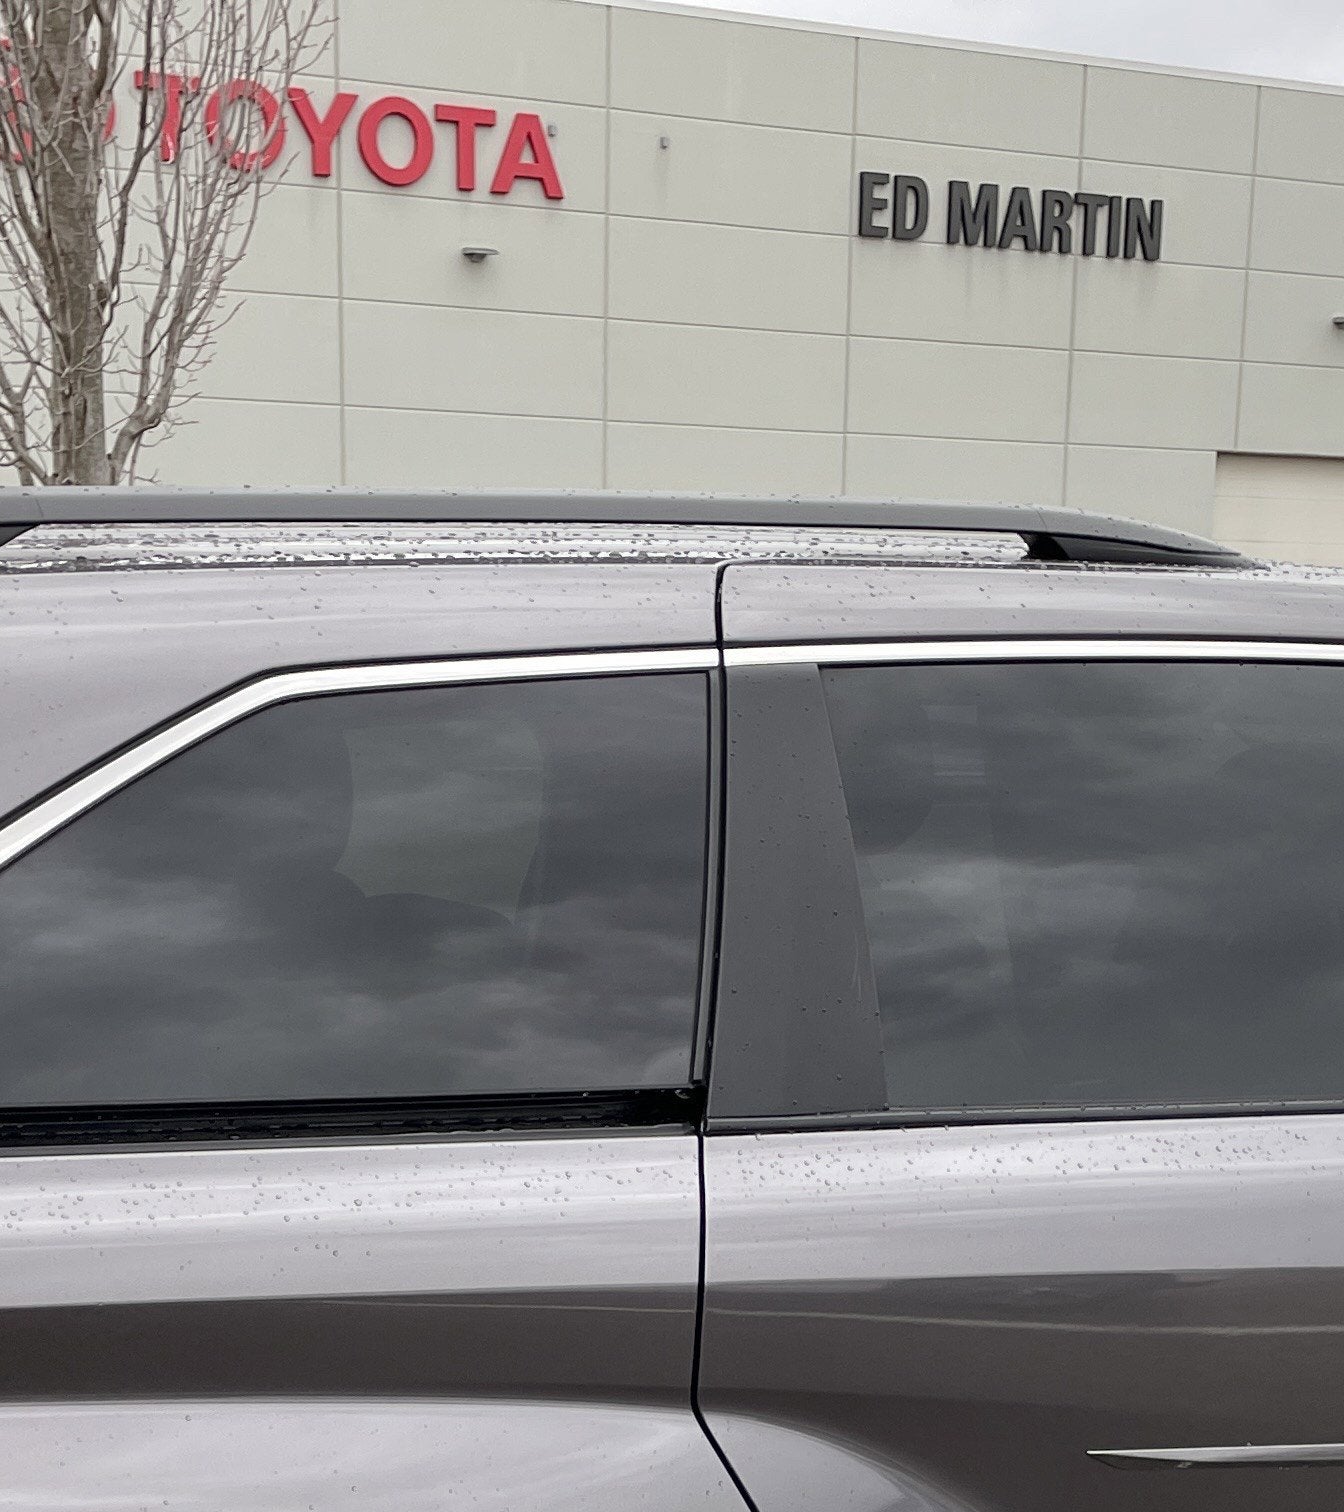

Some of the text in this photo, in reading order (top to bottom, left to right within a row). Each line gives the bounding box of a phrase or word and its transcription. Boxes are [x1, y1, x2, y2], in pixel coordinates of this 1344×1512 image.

[134, 70, 564, 200] TOYOTA
[859, 171, 1163, 261] ED MARTIN
